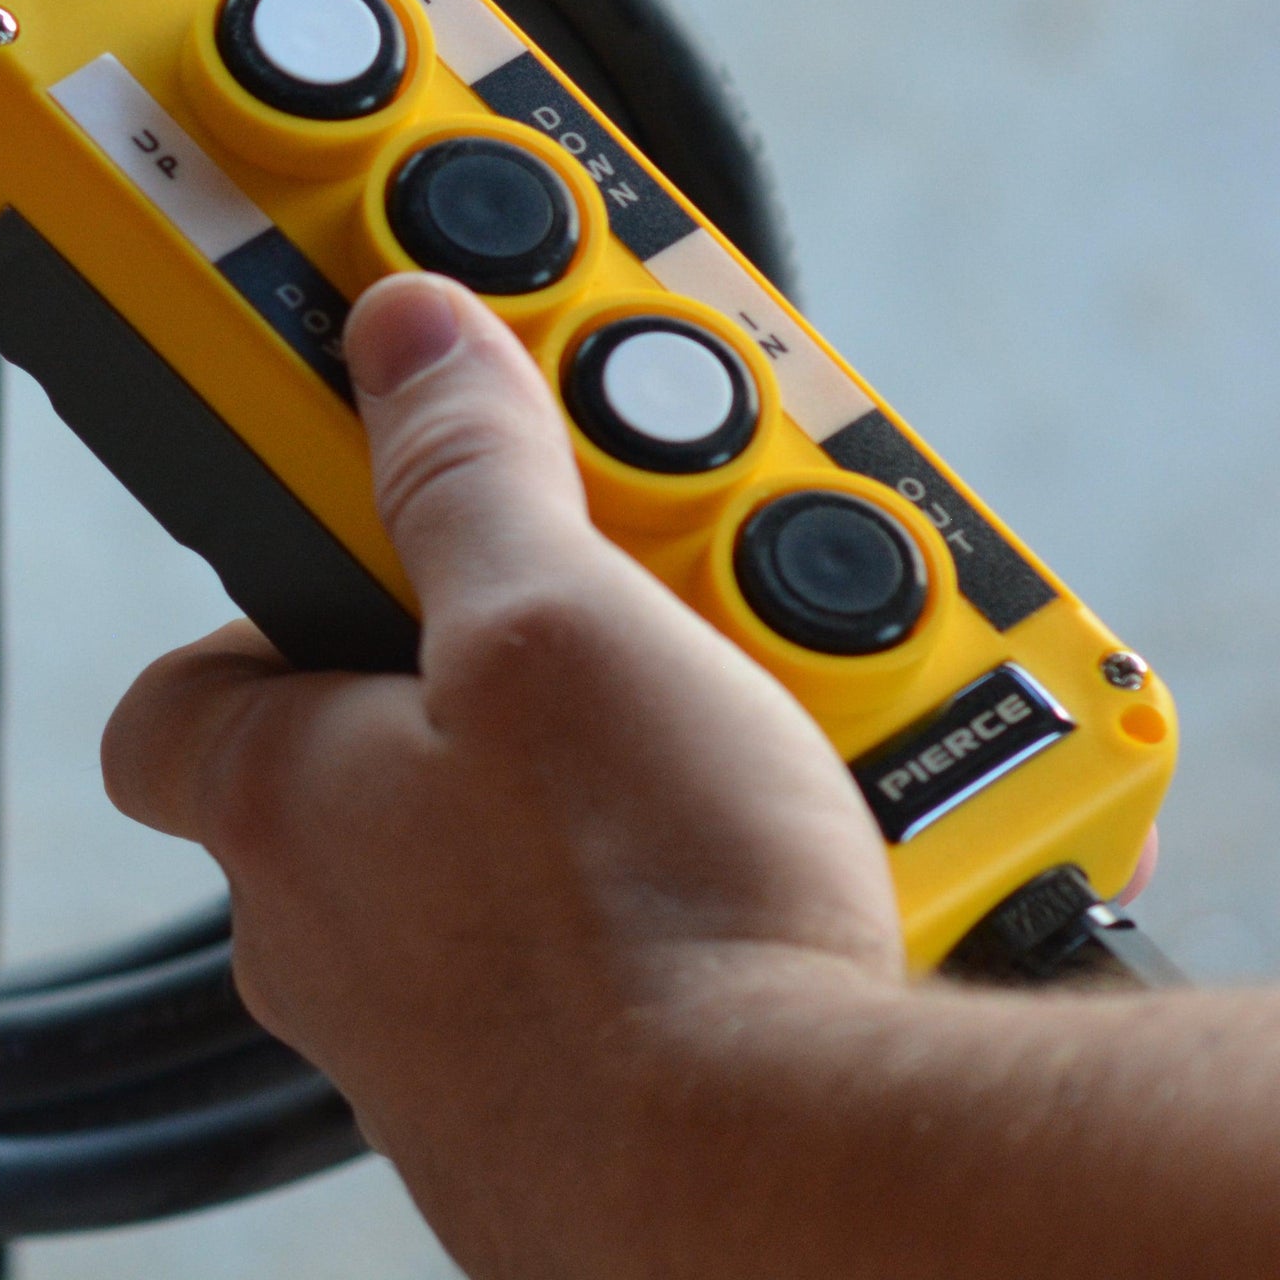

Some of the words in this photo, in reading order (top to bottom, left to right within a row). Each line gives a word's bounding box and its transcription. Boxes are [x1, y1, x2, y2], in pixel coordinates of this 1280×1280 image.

[131, 128, 180, 182] UP
[529, 104, 641, 208] DOWN
[739, 311, 789, 360] IN
[897, 476, 977, 555] OUT
[876, 691, 1034, 805] PIERCE
